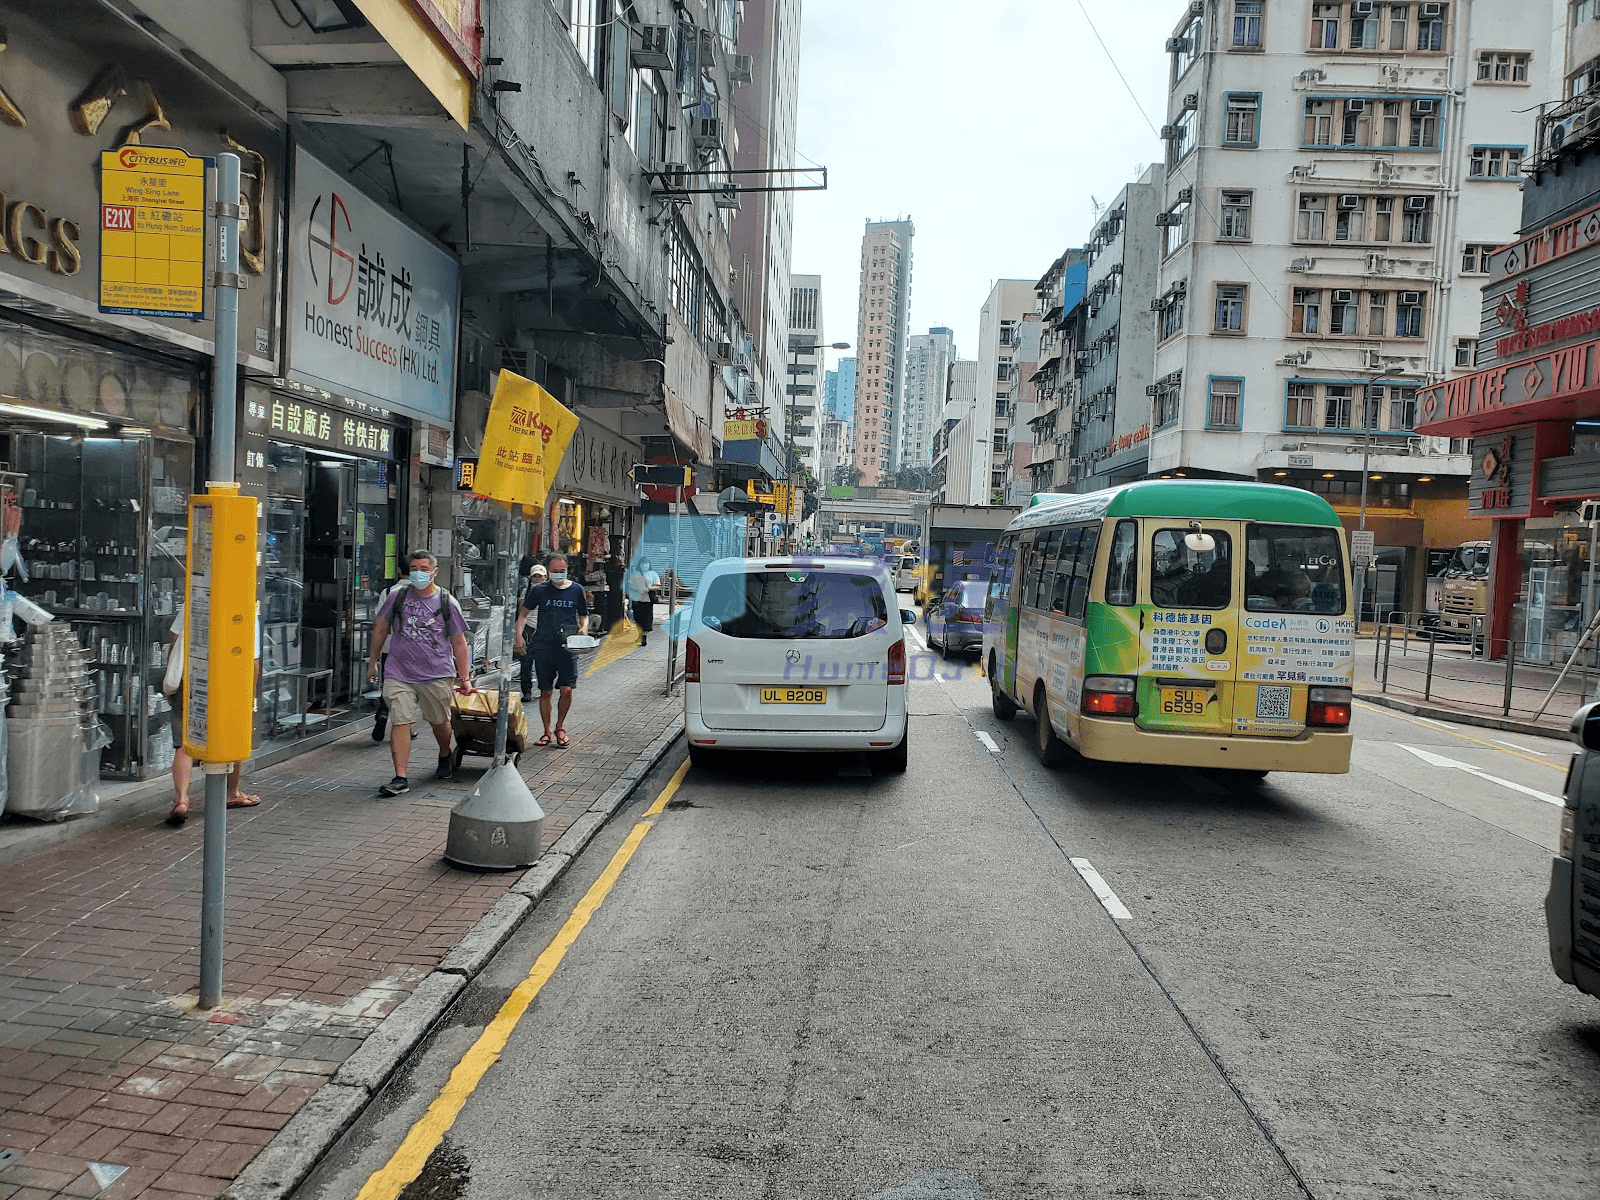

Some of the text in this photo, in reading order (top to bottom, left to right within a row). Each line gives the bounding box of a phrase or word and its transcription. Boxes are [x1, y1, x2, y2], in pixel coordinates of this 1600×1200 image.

[129, 155, 168, 165] CITYBUS
[126, 187, 180, 197] Wing Sing Lane
[105, 207, 132, 229] E21X
[147, 223, 163, 231] Hung
[180, 225, 202, 233] Station
[1524, 218, 1582, 269] YIU KEE
[357, 243, 413, 342] 誠成
[305, 301, 439, 385] Honest Success (HK) Ltd.
[1551, 346, 1588, 398] YIU
[1444, 366, 1509, 419] YIU KEE
[271, 400, 331, 441] 自設廠房
[343, 417, 390, 452] 特快訂做
[247, 450, 264, 468] 訂做
[460, 462, 475, 488] 周
[545, 599, 574, 608] AIGLE
[1153, 612, 1212, 625] 科德施基因
[1277, 670, 1307, 682] 罕見病
[764, 691, 823, 701] UL 8208
[1174, 690, 1194, 702] SU
[1164, 702, 1203, 714] 6599
